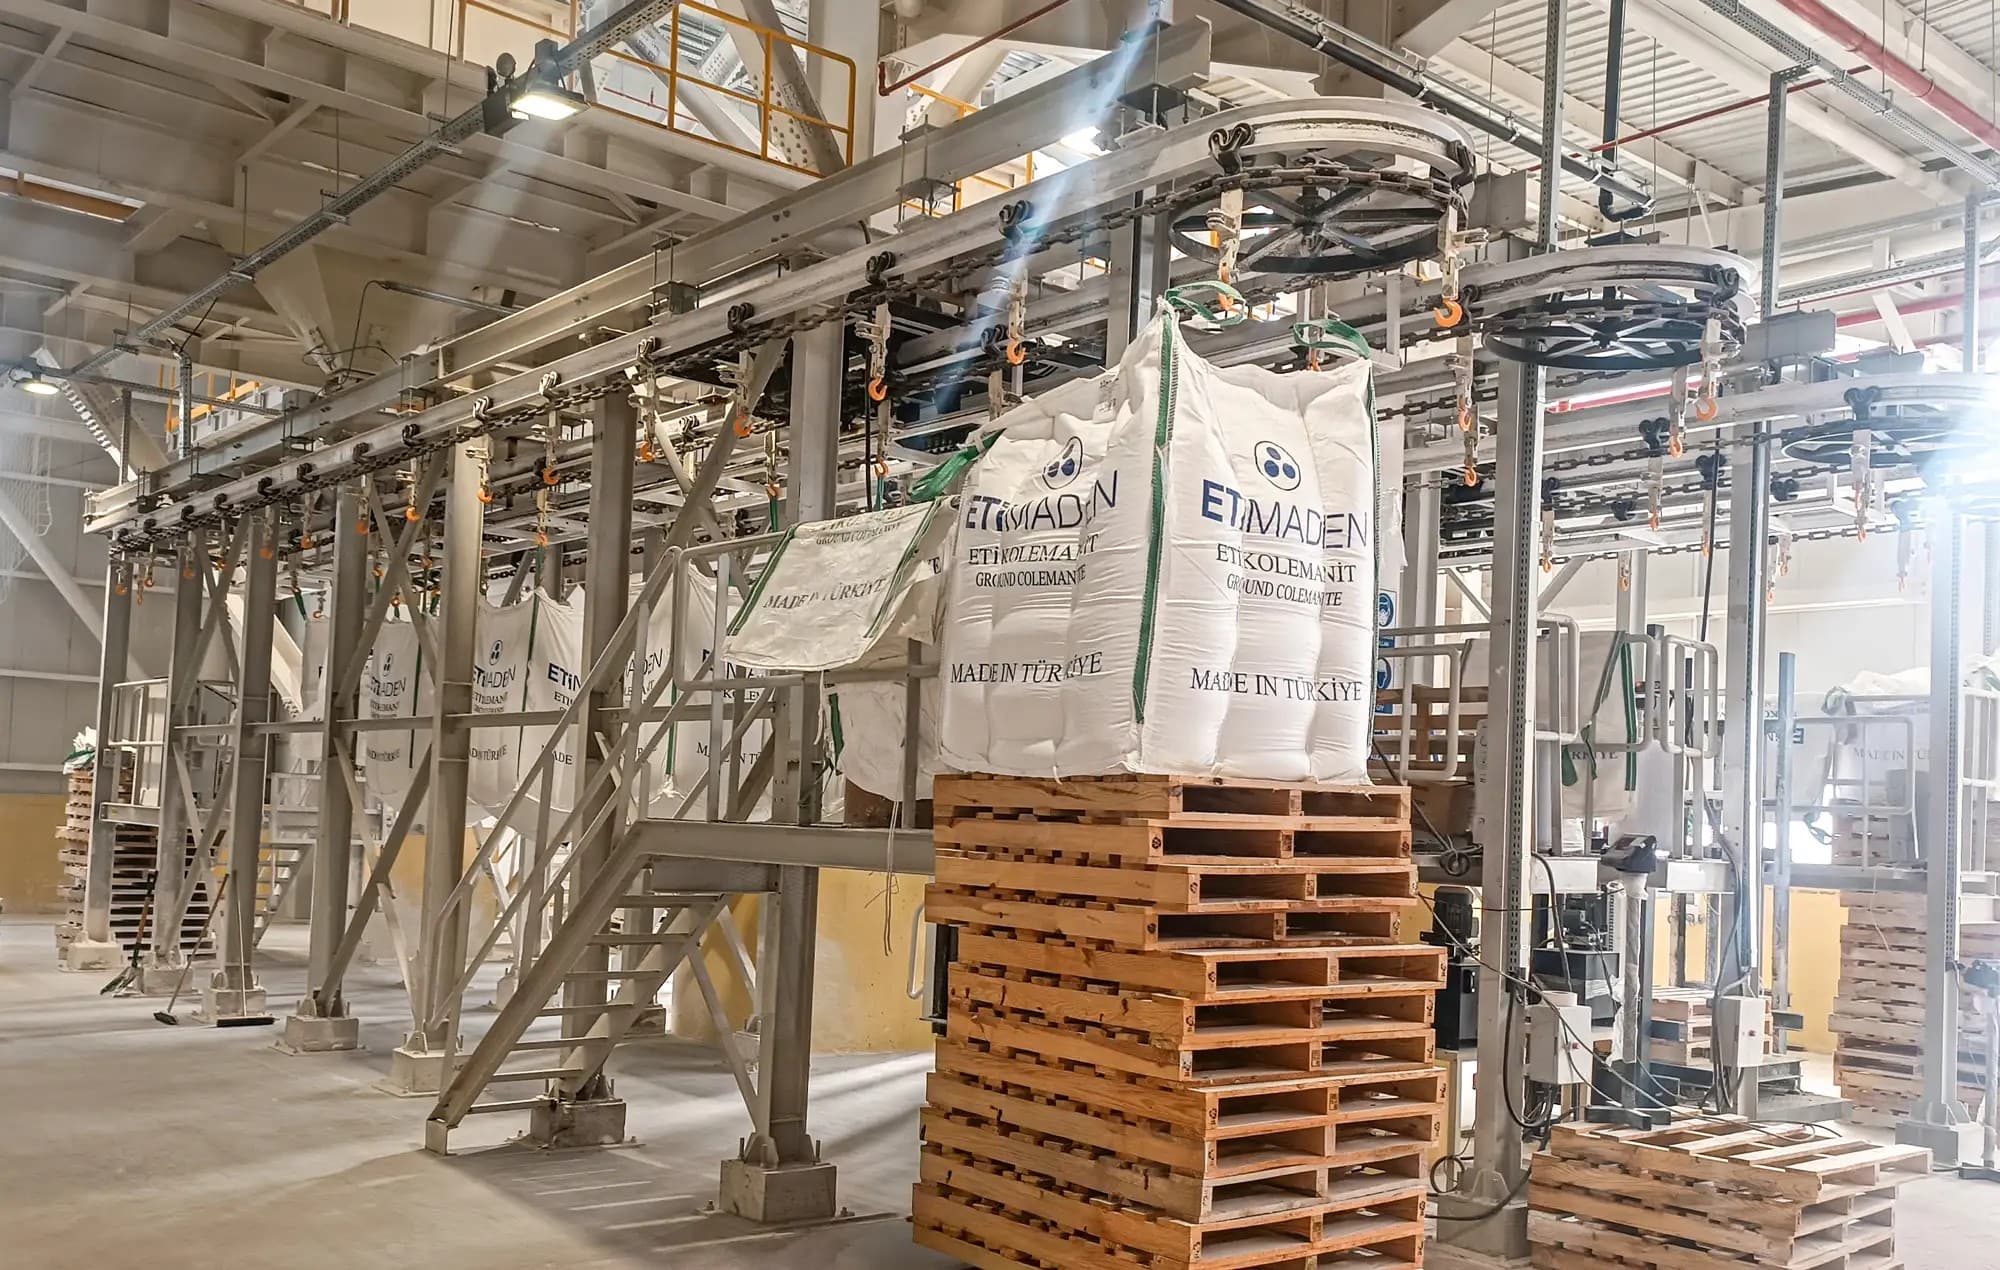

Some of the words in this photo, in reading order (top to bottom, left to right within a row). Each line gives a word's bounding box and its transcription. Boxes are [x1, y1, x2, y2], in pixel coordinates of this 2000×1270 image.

[1017, 564, 1086, 587] COLEMANTE
[950, 663, 998, 683] MADE
[1000, 663, 1018, 683] IN
[1190, 667, 1248, 694] MADE
[1255, 675, 1278, 697] IN
[1283, 676, 1363, 702] TÜRKİYE
